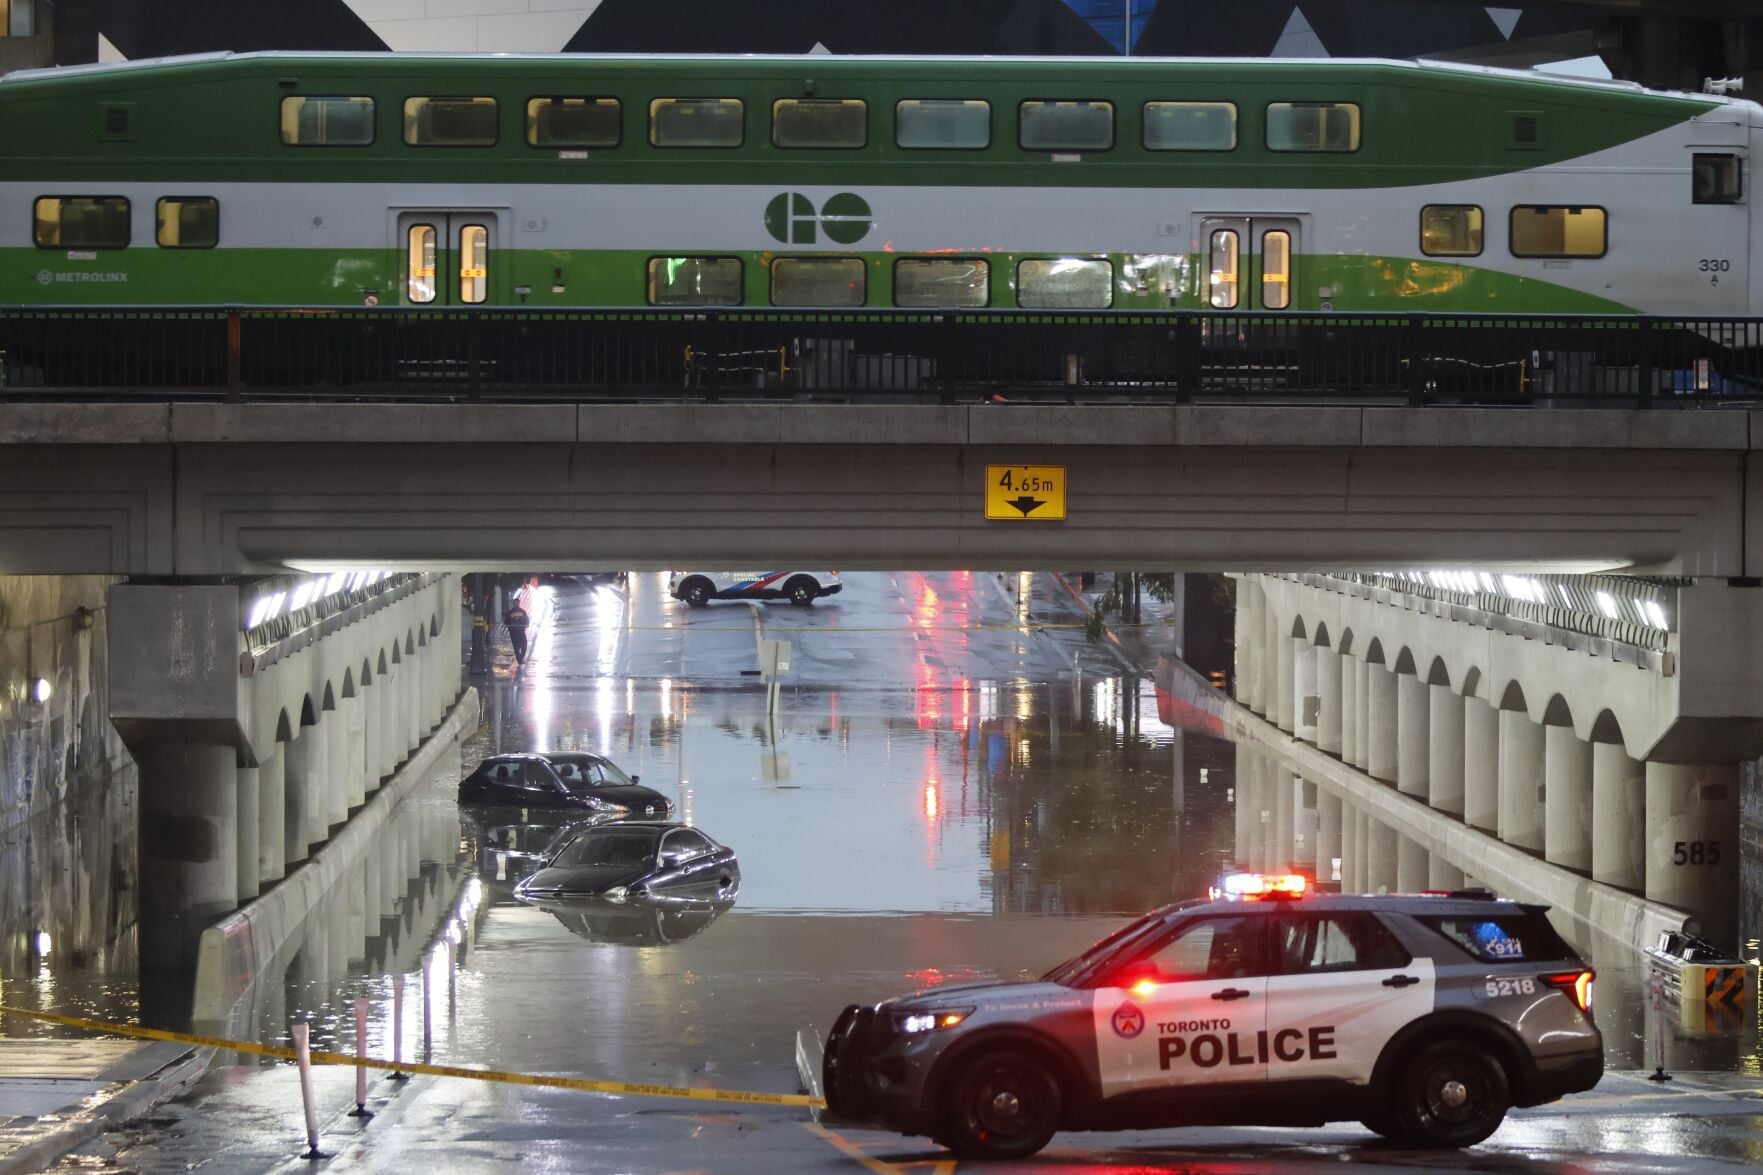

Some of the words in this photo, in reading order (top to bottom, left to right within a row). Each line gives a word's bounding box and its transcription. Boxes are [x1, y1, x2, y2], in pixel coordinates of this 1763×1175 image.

[764, 192, 873, 245] GO
[1699, 259, 1730, 272] 330
[55, 272, 129, 282] METROLINX
[999, 469, 1053, 492] 4.65m
[1674, 841, 1720, 866] 585
[1495, 941, 1523, 955] 911
[1485, 980, 1536, 998] 5218
[1156, 1018, 1231, 1034] TORONTO
[1158, 1025, 1338, 1071] POLICE
